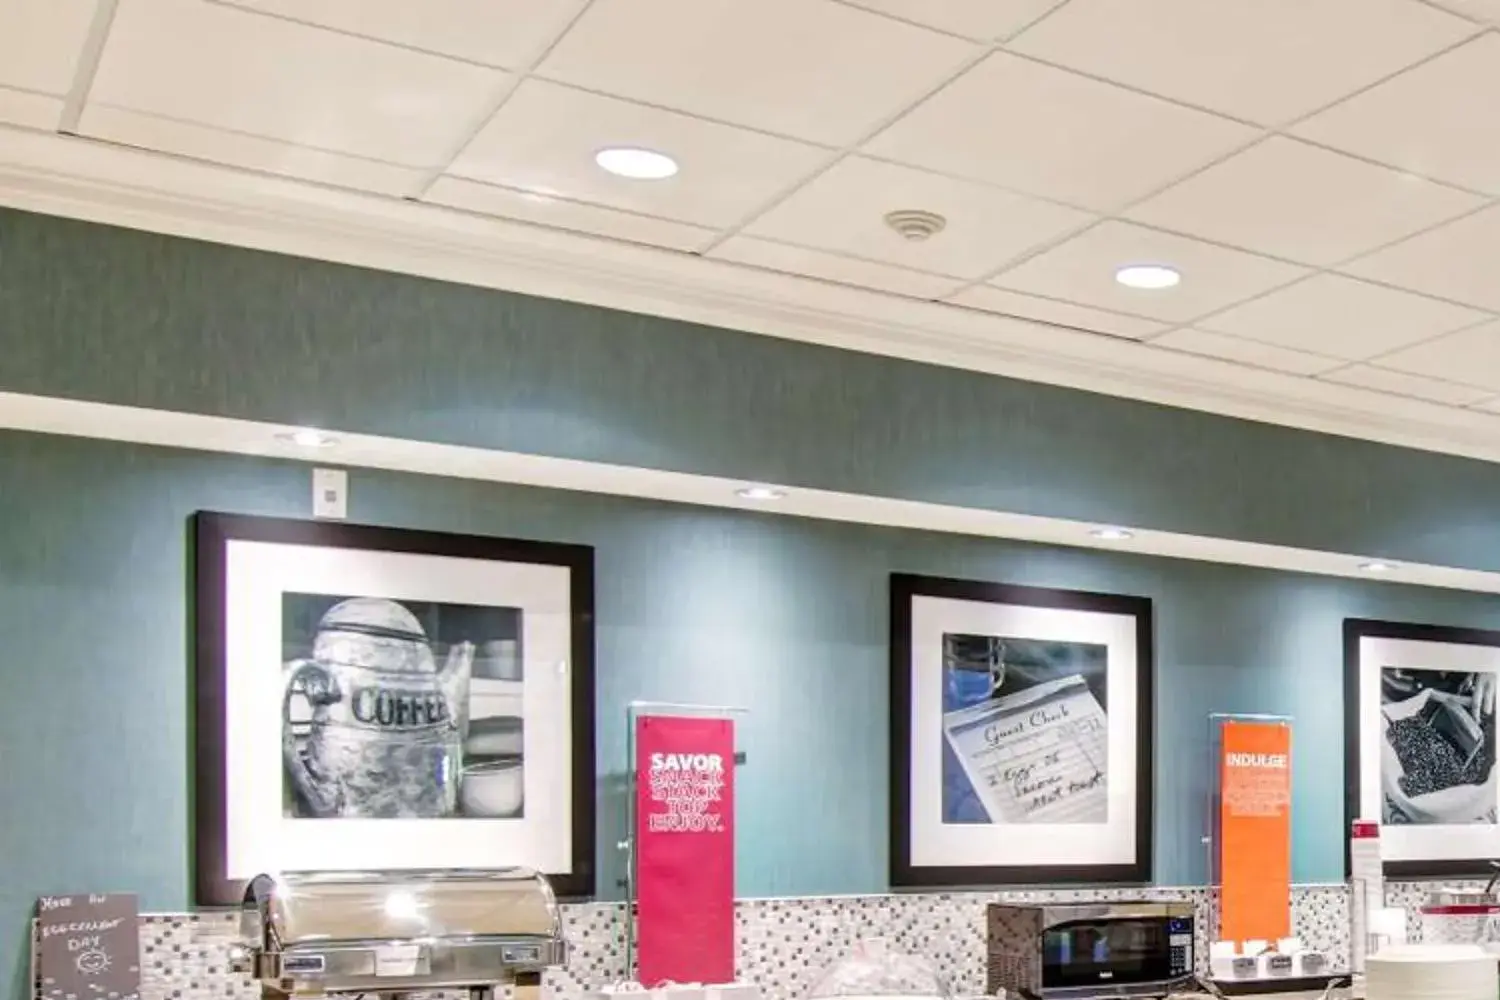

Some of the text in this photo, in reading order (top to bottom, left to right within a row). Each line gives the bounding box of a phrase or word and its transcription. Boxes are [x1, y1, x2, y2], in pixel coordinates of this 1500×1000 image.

[984, 722, 1025, 748] Guest
[1029, 704, 1069, 727] Check
[651, 754, 722, 771] SAVOR
[1226, 752, 1287, 768] INDULGE
[68, 935, 99, 952] DAY
